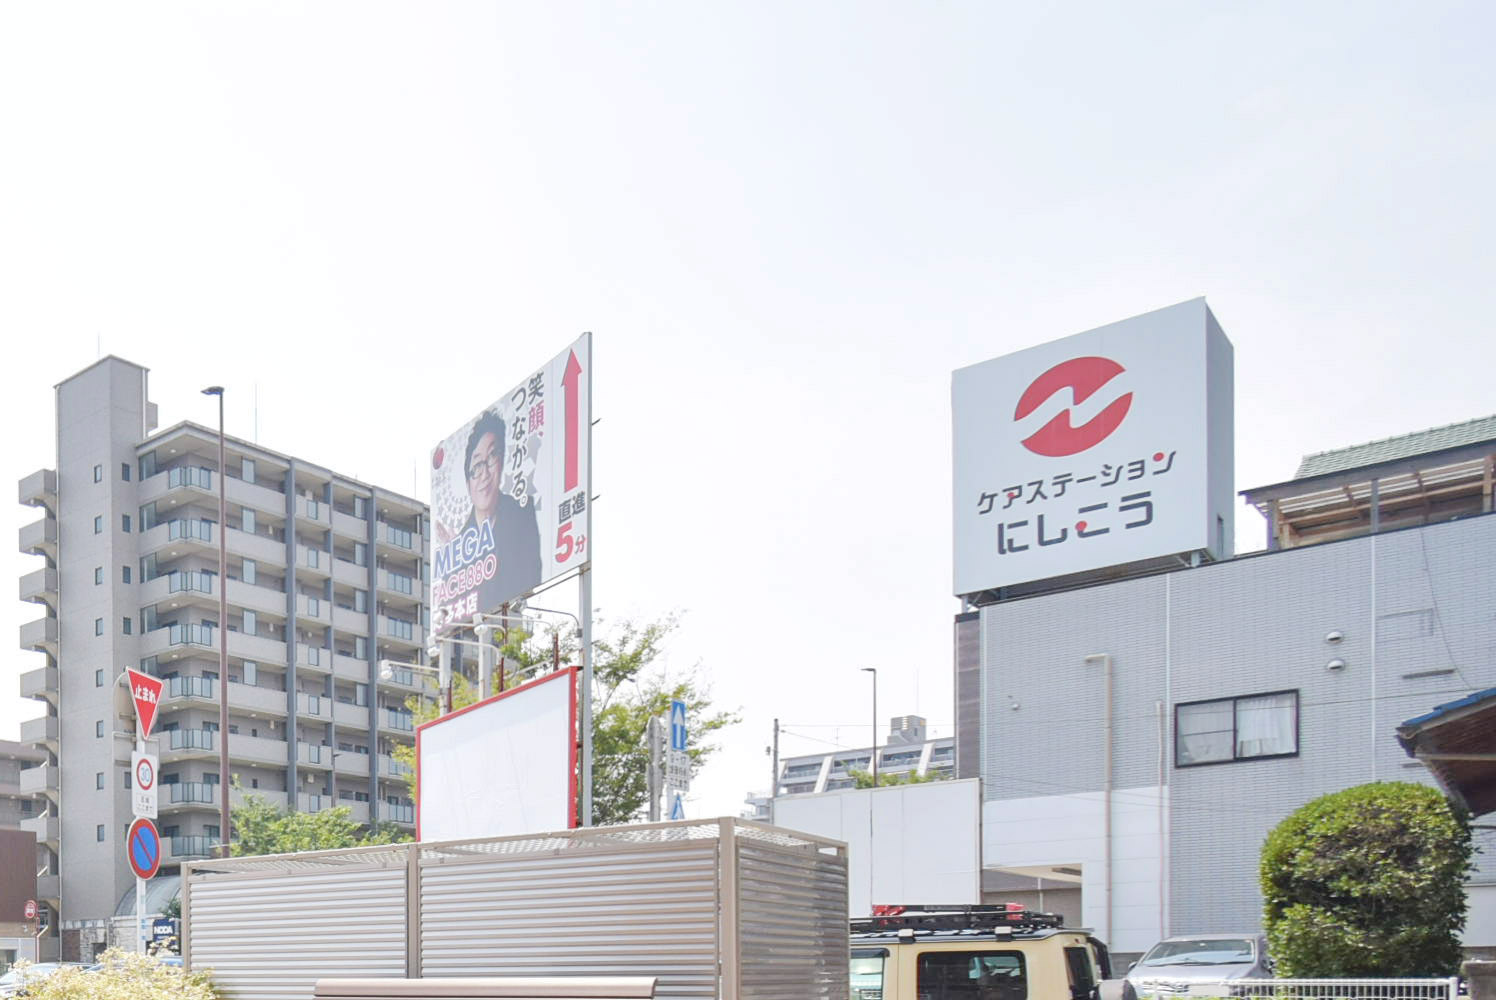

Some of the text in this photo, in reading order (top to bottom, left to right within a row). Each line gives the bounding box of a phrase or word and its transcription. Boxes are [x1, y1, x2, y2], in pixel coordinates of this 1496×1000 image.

[510, 387, 529, 509] つながる。
[557, 490, 586, 526] 直進
[977, 450, 1177, 516] ケアステーション
[433, 519, 495, 579] MEGA
[997, 490, 1154, 555] にしこう
[432, 553, 497, 608] FACE880
[134, 683, 157, 705] 止まれ
[140, 766, 150, 783] 30
